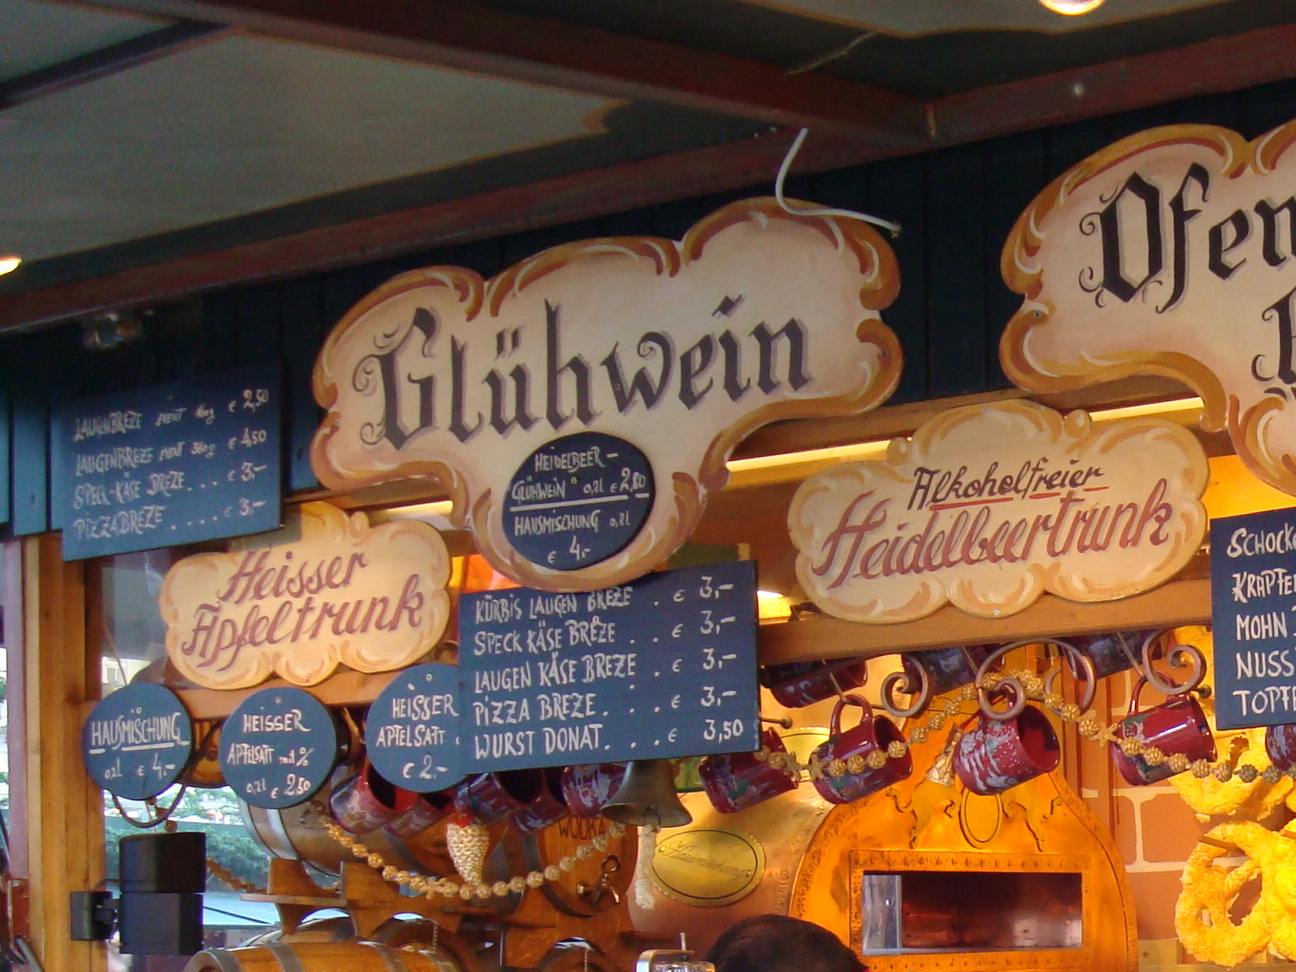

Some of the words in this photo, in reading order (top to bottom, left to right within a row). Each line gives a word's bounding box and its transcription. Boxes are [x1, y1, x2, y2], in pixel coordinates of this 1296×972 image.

[351, 294, 815, 450] Glühwein
[243, 389, 269, 413] 2,50
[147, 471, 185, 497] BREZE
[512, 475, 566, 504] GLÜHWEIN
[610, 482, 618, 493] €
[907, 457, 1106, 511] Alkoholfreier
[514, 509, 601, 537] HAUSMISCHUNG
[811, 478, 1173, 590] Heidelbeertrunk
[548, 551, 556, 564] €
[217, 545, 368, 605] Heisser
[529, 594, 577, 621] LAUGEN
[587, 586, 633, 611] BREZE
[673, 589, 685, 602] €
[182, 573, 424, 672] Apfeltrunk
[474, 630, 521, 656] SPECK
[527, 620, 562, 654] KÄSE
[565, 619, 616, 647] BREZE
[672, 624, 684, 638] €
[1236, 611, 1287, 642] MOHN
[474, 661, 532, 694] LAUGEN
[538, 651, 578, 687] KÄSE
[581, 653, 637, 683] BREZE
[672, 659, 683, 673] €
[392, 685, 460, 721] HEISSER
[538, 692, 597, 721] BREZE
[670, 694, 681, 710] €
[91, 709, 182, 750] HAUSMISCHUNG
[243, 706, 312, 733] HEISSER
[376, 724, 446, 747] APFELSAFT
[475, 730, 535, 760] WURST
[542, 724, 603, 752] DONAT
[668, 728, 677, 743] €
[703, 719, 744, 743] 3,50
[138, 765, 145, 776] €
[270, 787, 279, 799] €
[558, 815, 607, 840] WODKA
